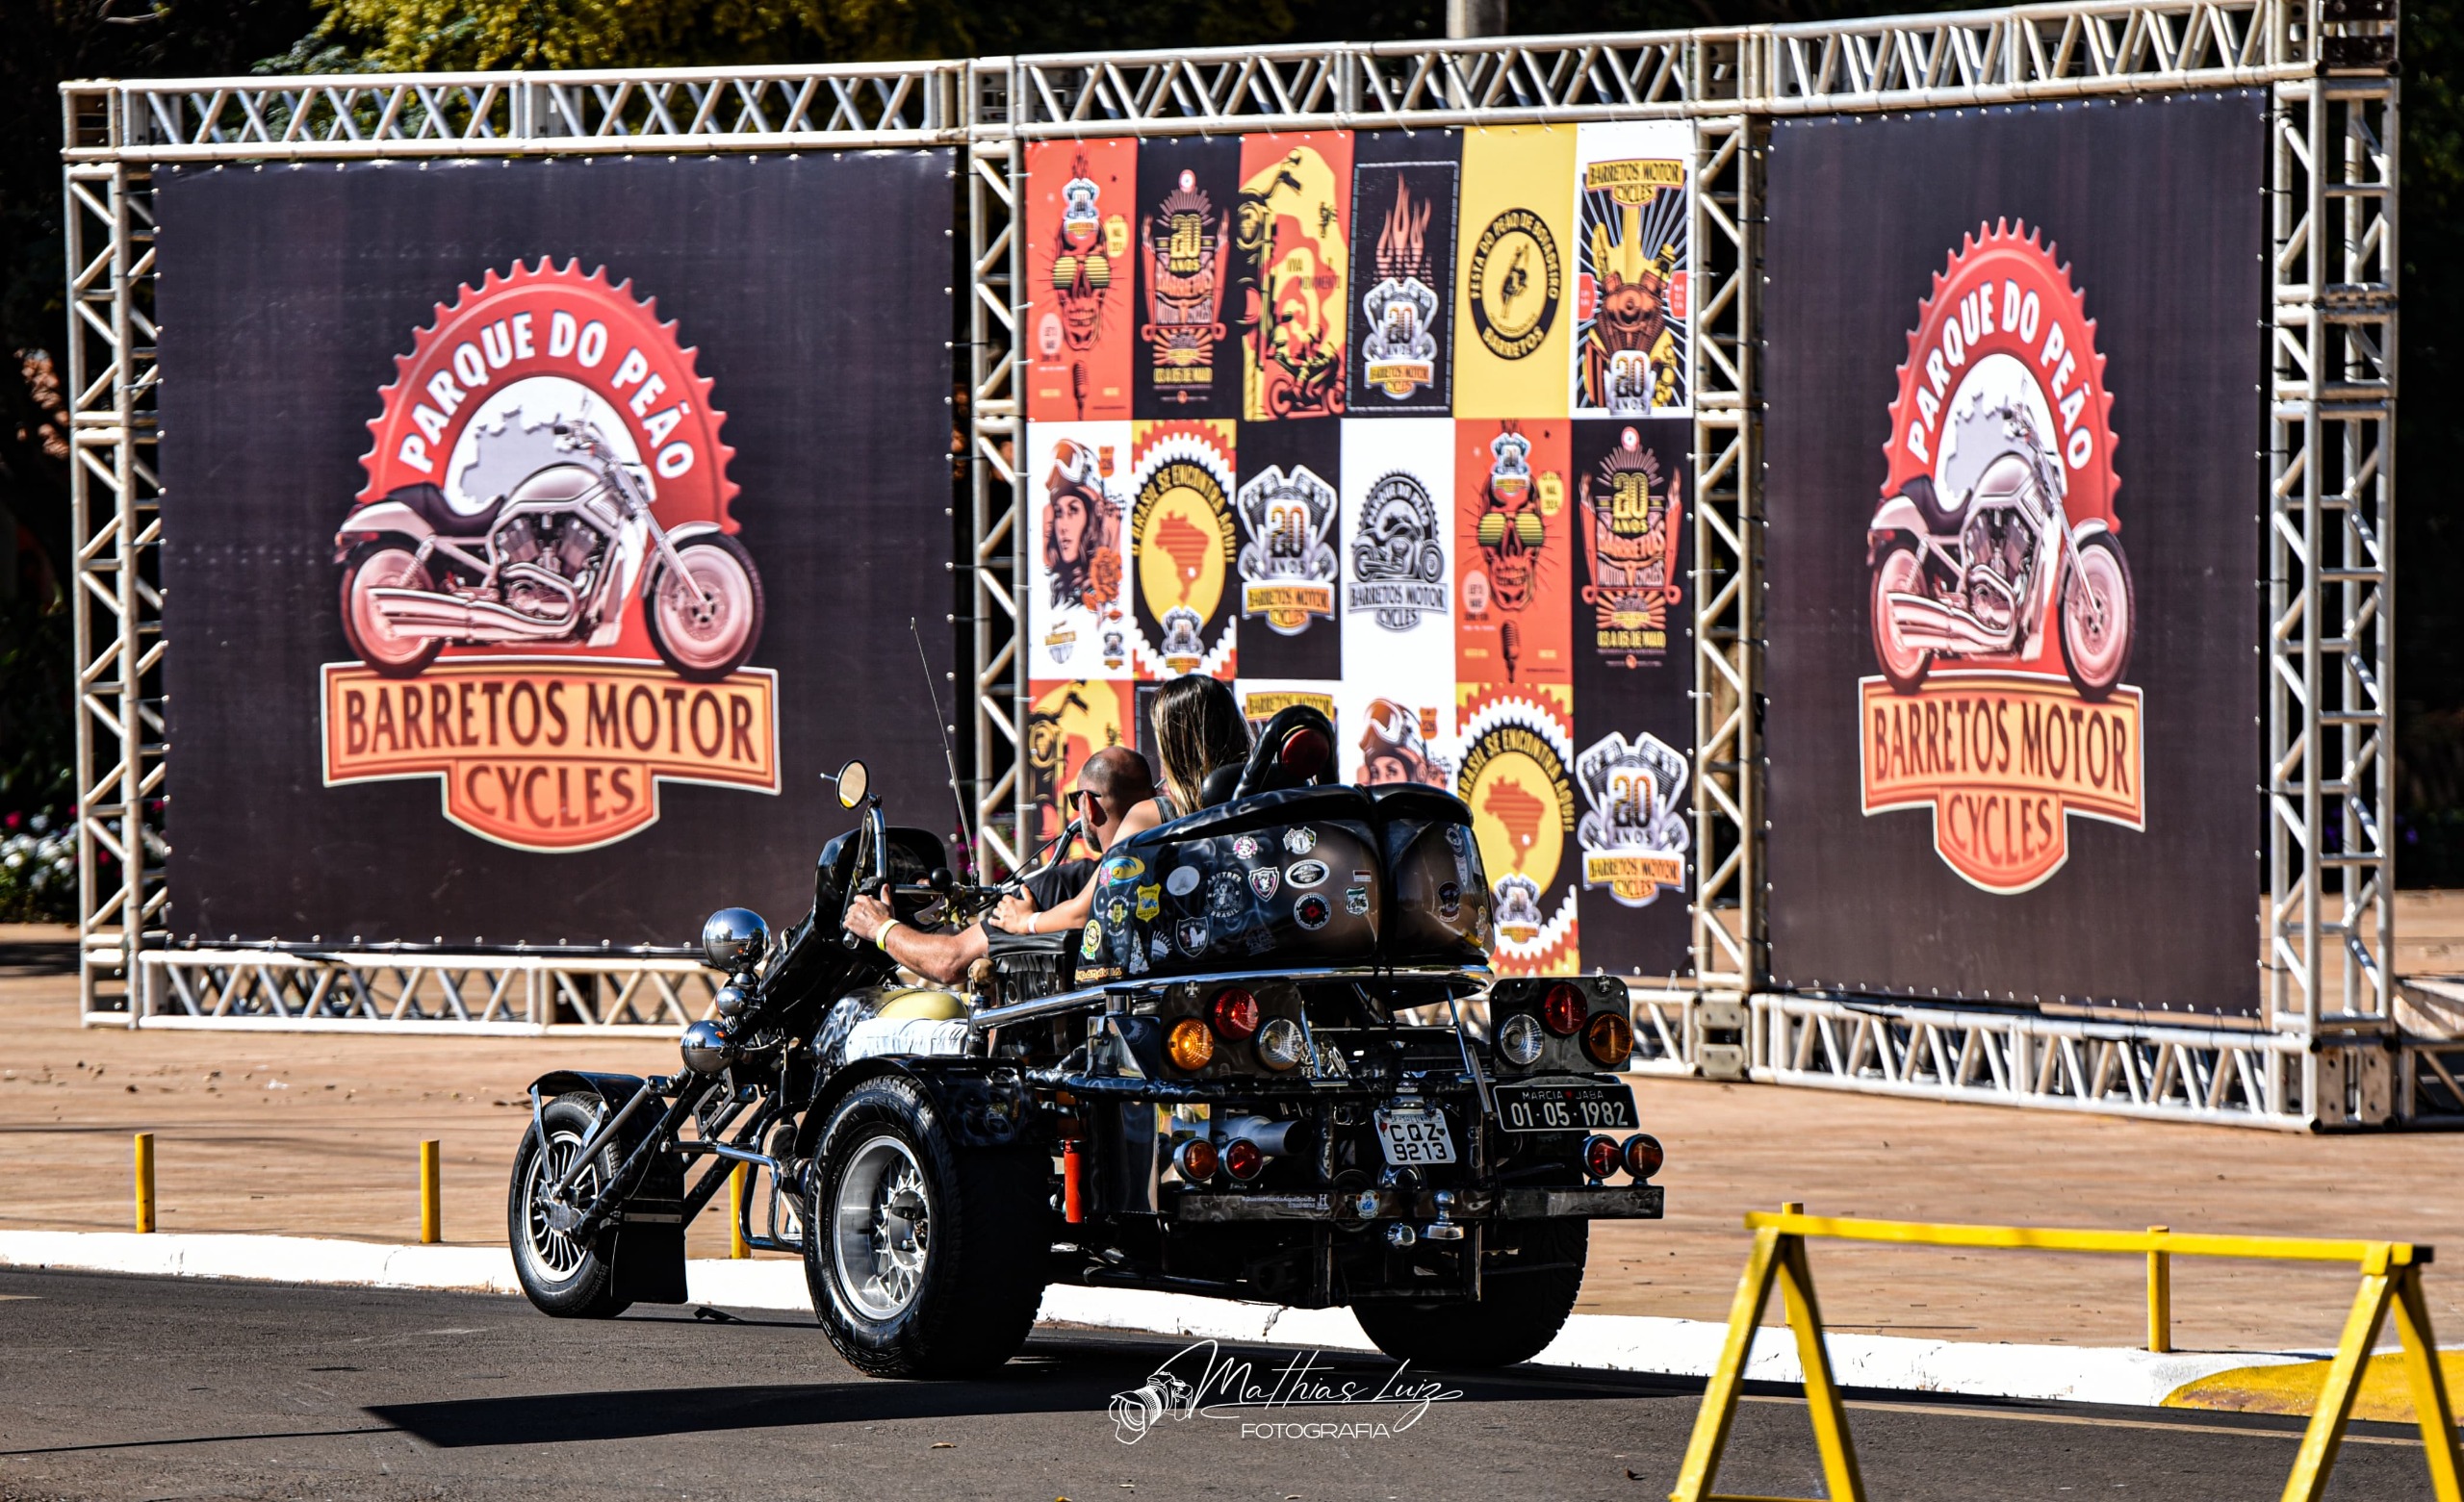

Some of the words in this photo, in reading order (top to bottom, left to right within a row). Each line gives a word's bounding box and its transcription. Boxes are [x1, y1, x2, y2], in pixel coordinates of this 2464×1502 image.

[1589, 164, 1639, 185] BARRETOS
[1642, 163, 1680, 182] MOTOR
[1170, 214, 1201, 258] 20
[1388, 307, 1412, 344] 20
[398, 313, 535, 473] PARQUE
[549, 310, 608, 367] DO
[612, 347, 695, 479] PEÃO
[1616, 356, 1644, 397] 20
[1908, 281, 1994, 464] PARQUE
[2002, 279, 2040, 344] DO
[2040, 321, 2092, 470] PEÃO
[1613, 472, 1649, 519] 20
[1271, 506, 1305, 557] 20
[1350, 584, 1402, 606] BARRETOS
[1406, 583, 1444, 607] MOTOR
[1377, 608, 1417, 626] CYCLES
[345, 680, 569, 756] BARRETOS
[585, 683, 757, 764] MOTOR
[1874, 698, 2010, 780] BARRETOS
[2021, 700, 2129, 795] MOTOR
[465, 763, 634, 828] CYCLES
[1614, 776, 1652, 827] 20
[1948, 793, 2052, 866] CYCLES
[1522, 1090, 1565, 1101] MARCIA
[1390, 1124, 1440, 1142] CQZ
[1393, 1142, 1448, 1161] 9213
